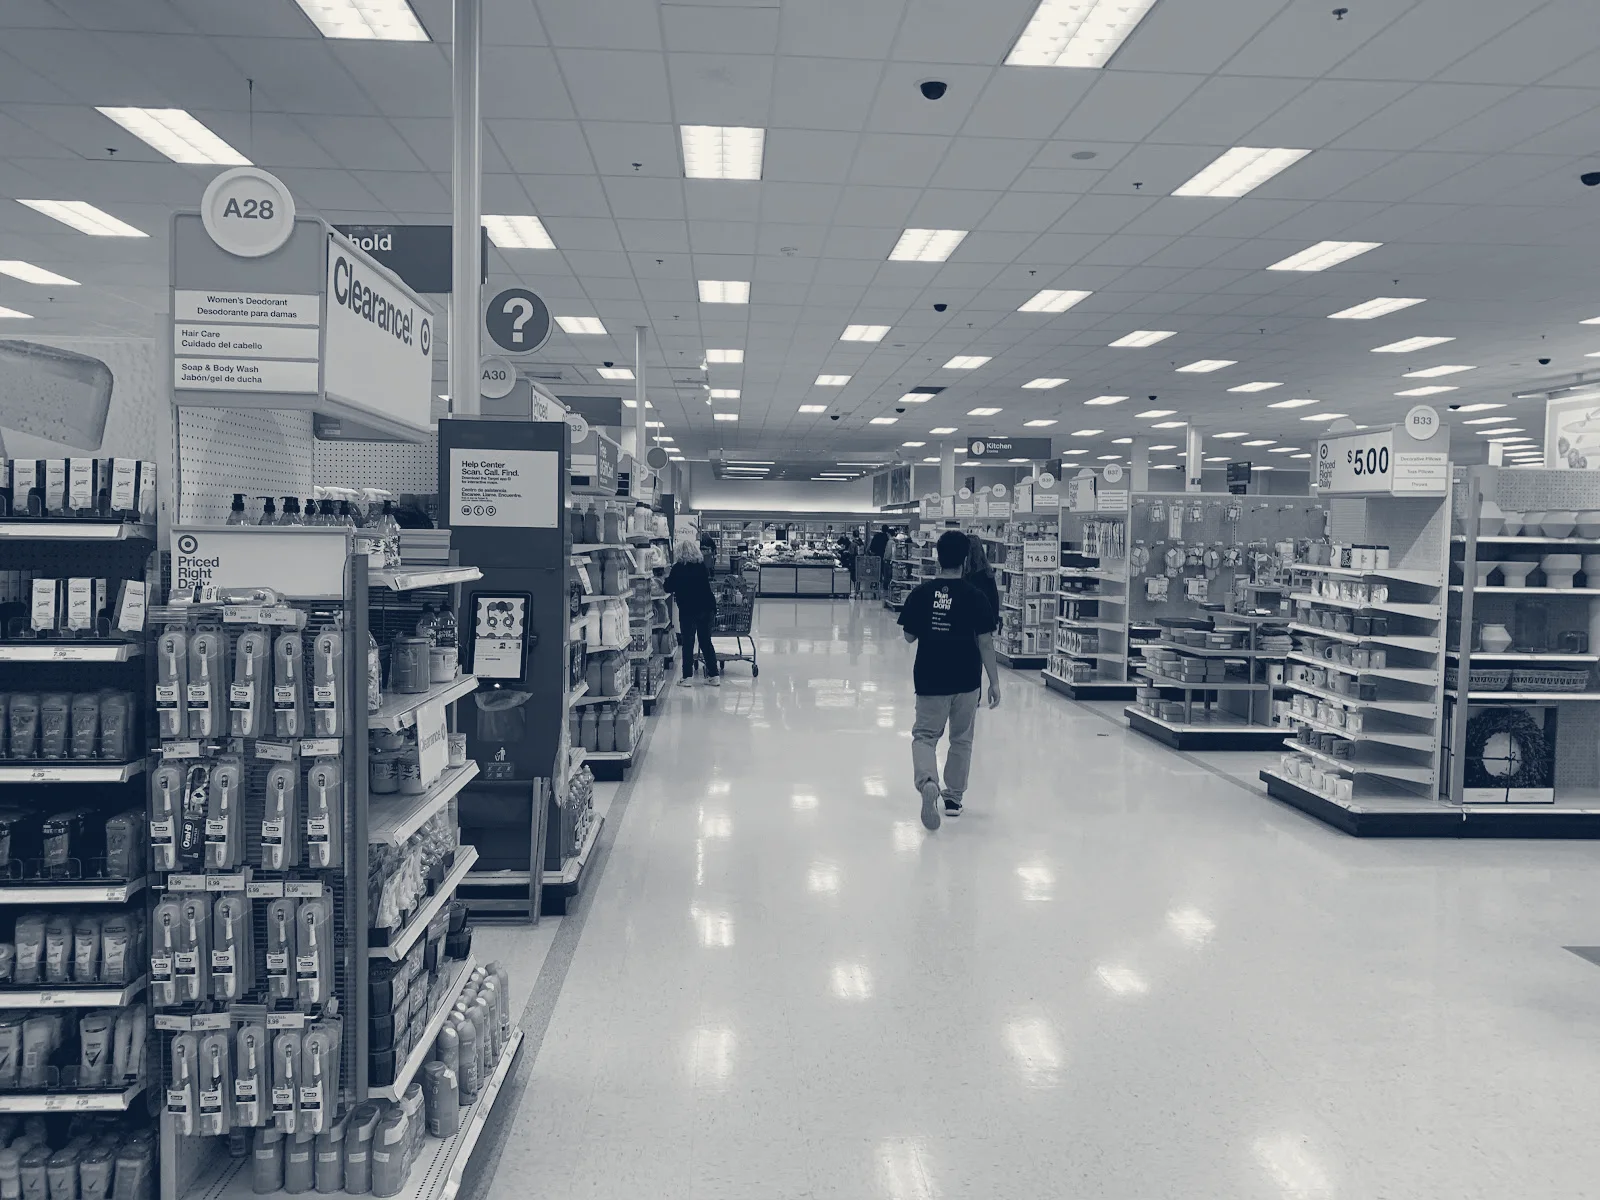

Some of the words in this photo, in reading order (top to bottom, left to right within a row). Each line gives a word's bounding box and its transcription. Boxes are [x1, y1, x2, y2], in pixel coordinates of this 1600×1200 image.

[223, 198, 274, 220] A28
[207, 295, 243, 304] Women's
[246, 297, 288, 306] Deodorant
[333, 256, 413, 347] Clearance!
[197, 307, 248, 316] Desodorante
[270, 310, 297, 318] damas
[181, 329, 199, 337] Hair
[201, 330, 220, 338] Care
[181, 340, 216, 348] Cuidado
[233, 341, 262, 350] cabello
[181, 363, 202, 372] Soap
[213, 364, 234, 373] Body
[236, 365, 259, 373] Wash
[181, 374, 222, 383] Jabón/gel
[237, 375, 262, 383] ducha
[482, 370, 506, 380] A30
[534, 395, 548, 420] Priced
[1413, 417, 1432, 425] B33
[986, 442, 1012, 450] Kitchen
[461, 460, 479, 468] Help
[1319, 460, 1335, 469] Priced
[1347, 446, 1388, 475] $5.00
[461, 468, 482, 476] Scan.
[484, 468, 500, 476] Call.
[1319, 470, 1332, 479] Right
[1319, 479, 1332, 489] Daily
[178, 556, 219, 567] Priced
[178, 568, 212, 580] Right
[934, 590, 948, 599] Run
[933, 600, 951, 610] Done
[182, 824, 192, 847] Oral-B
